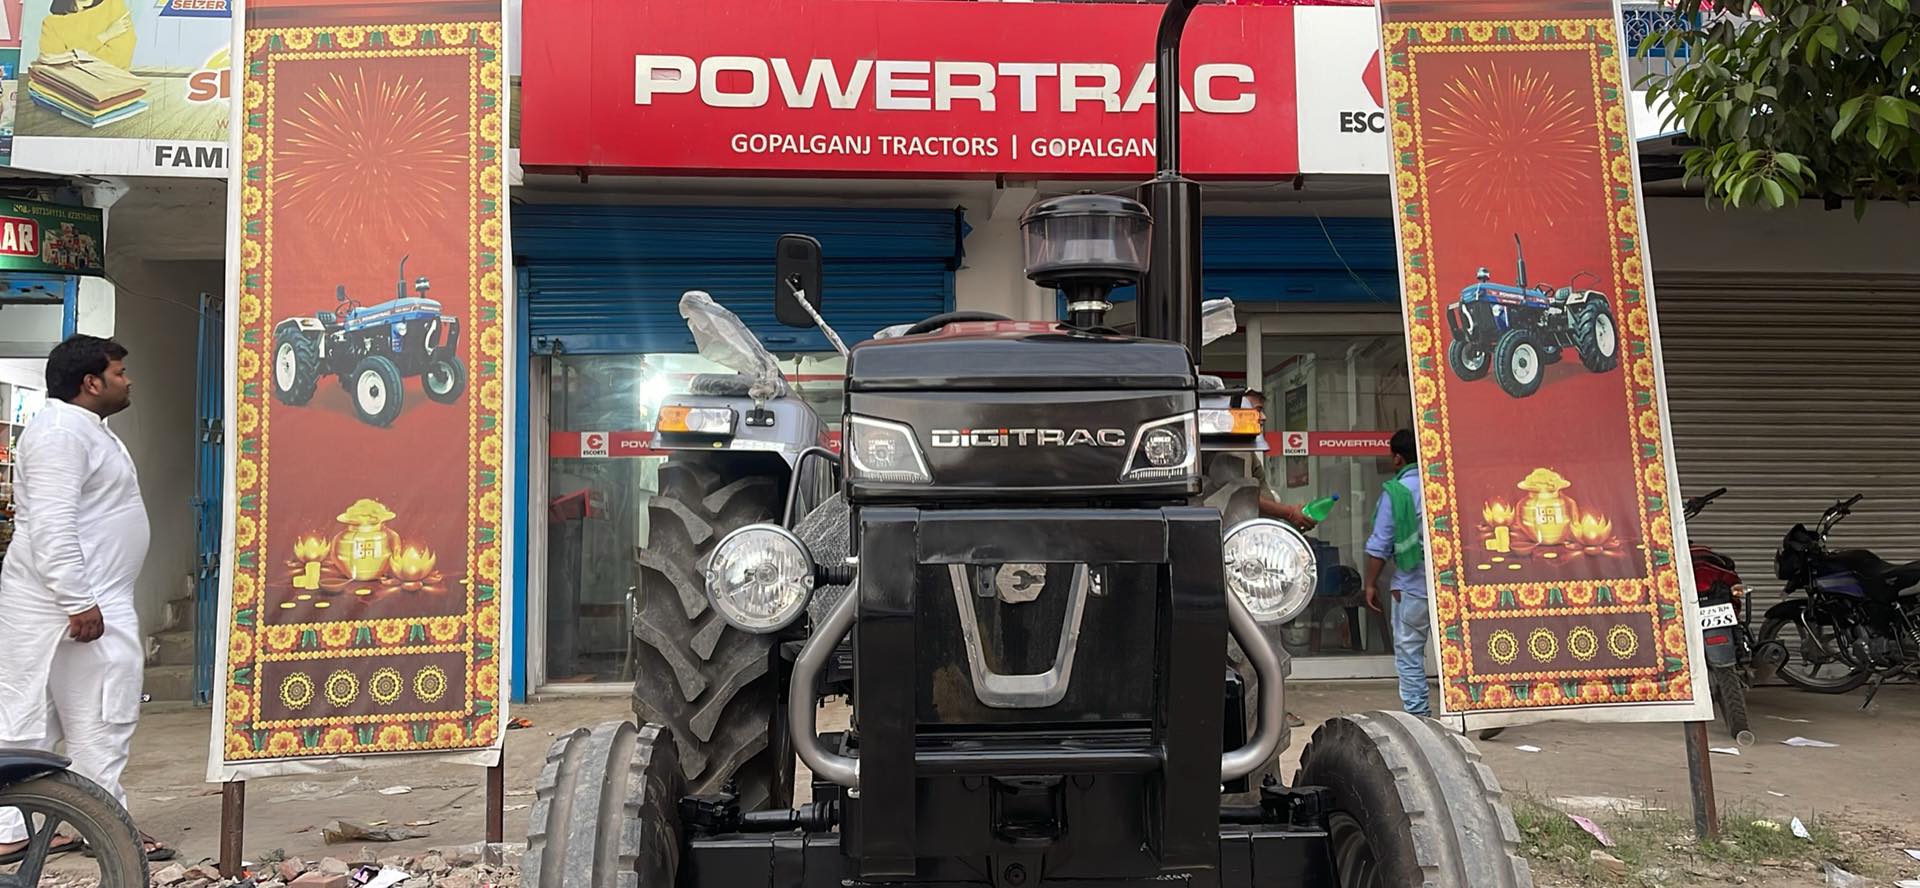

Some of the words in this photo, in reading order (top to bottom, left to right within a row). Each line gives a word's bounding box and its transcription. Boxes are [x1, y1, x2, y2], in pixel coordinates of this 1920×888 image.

[173, 0, 227, 10] SELZER
[634, 54, 1258, 114] POWERTRAC
[154, 145, 230, 169] FAM
[731, 133, 871, 157] GOPALGANJ
[878, 135, 999, 158] TRACTORS
[1030, 137, 1157, 158] GOPALGAN
[1, 221, 35, 253] AR
[1318, 438, 1391, 448] POWERTRAC
